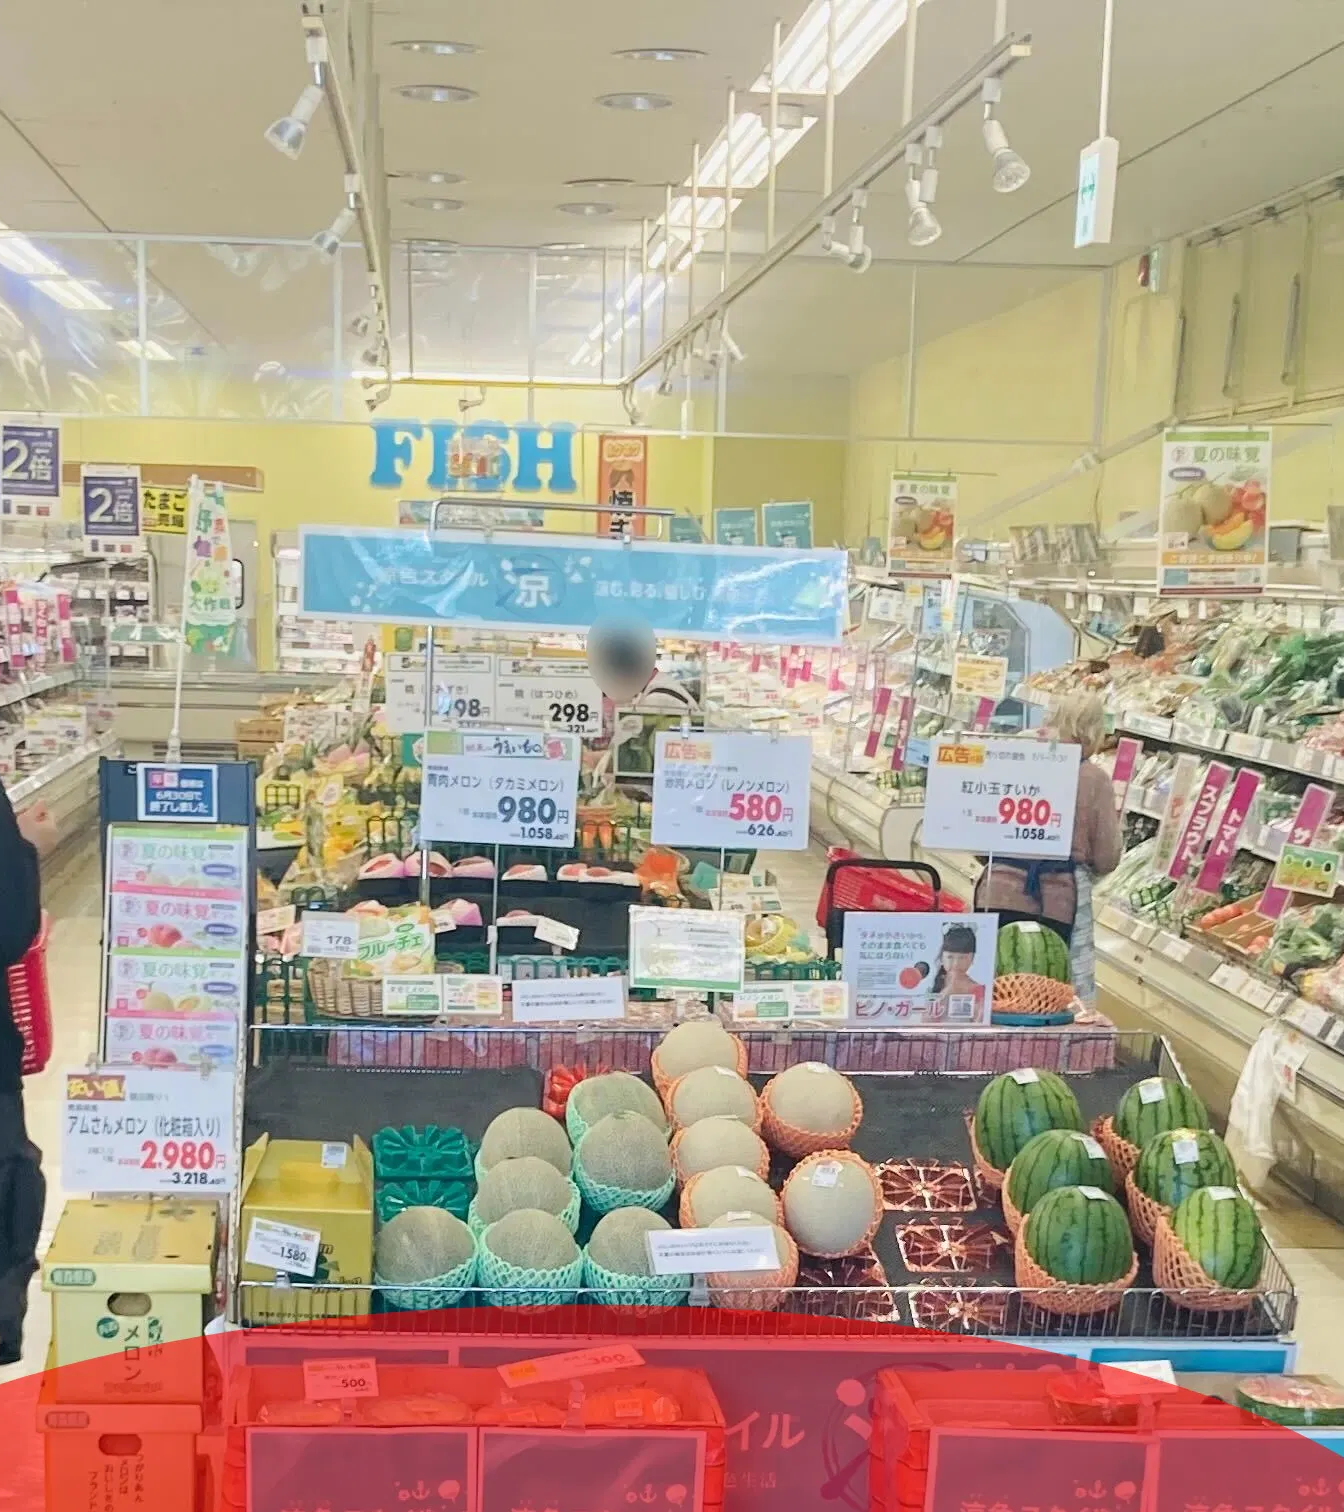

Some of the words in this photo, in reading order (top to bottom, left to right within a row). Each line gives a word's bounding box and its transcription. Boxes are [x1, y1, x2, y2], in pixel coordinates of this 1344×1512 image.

[142, 489, 187, 513] たまご
[960, 779, 1041, 797] 紅小玉すいか
[1215, 808, 1244, 857] トマト
[326, 934, 353, 946] 178
[358, 931, 425, 962] フルーチェ
[855, 999, 946, 1018] ピノ・ガール
[123, 1324, 142, 1382] メロン
[341, 1377, 367, 1389] 500
